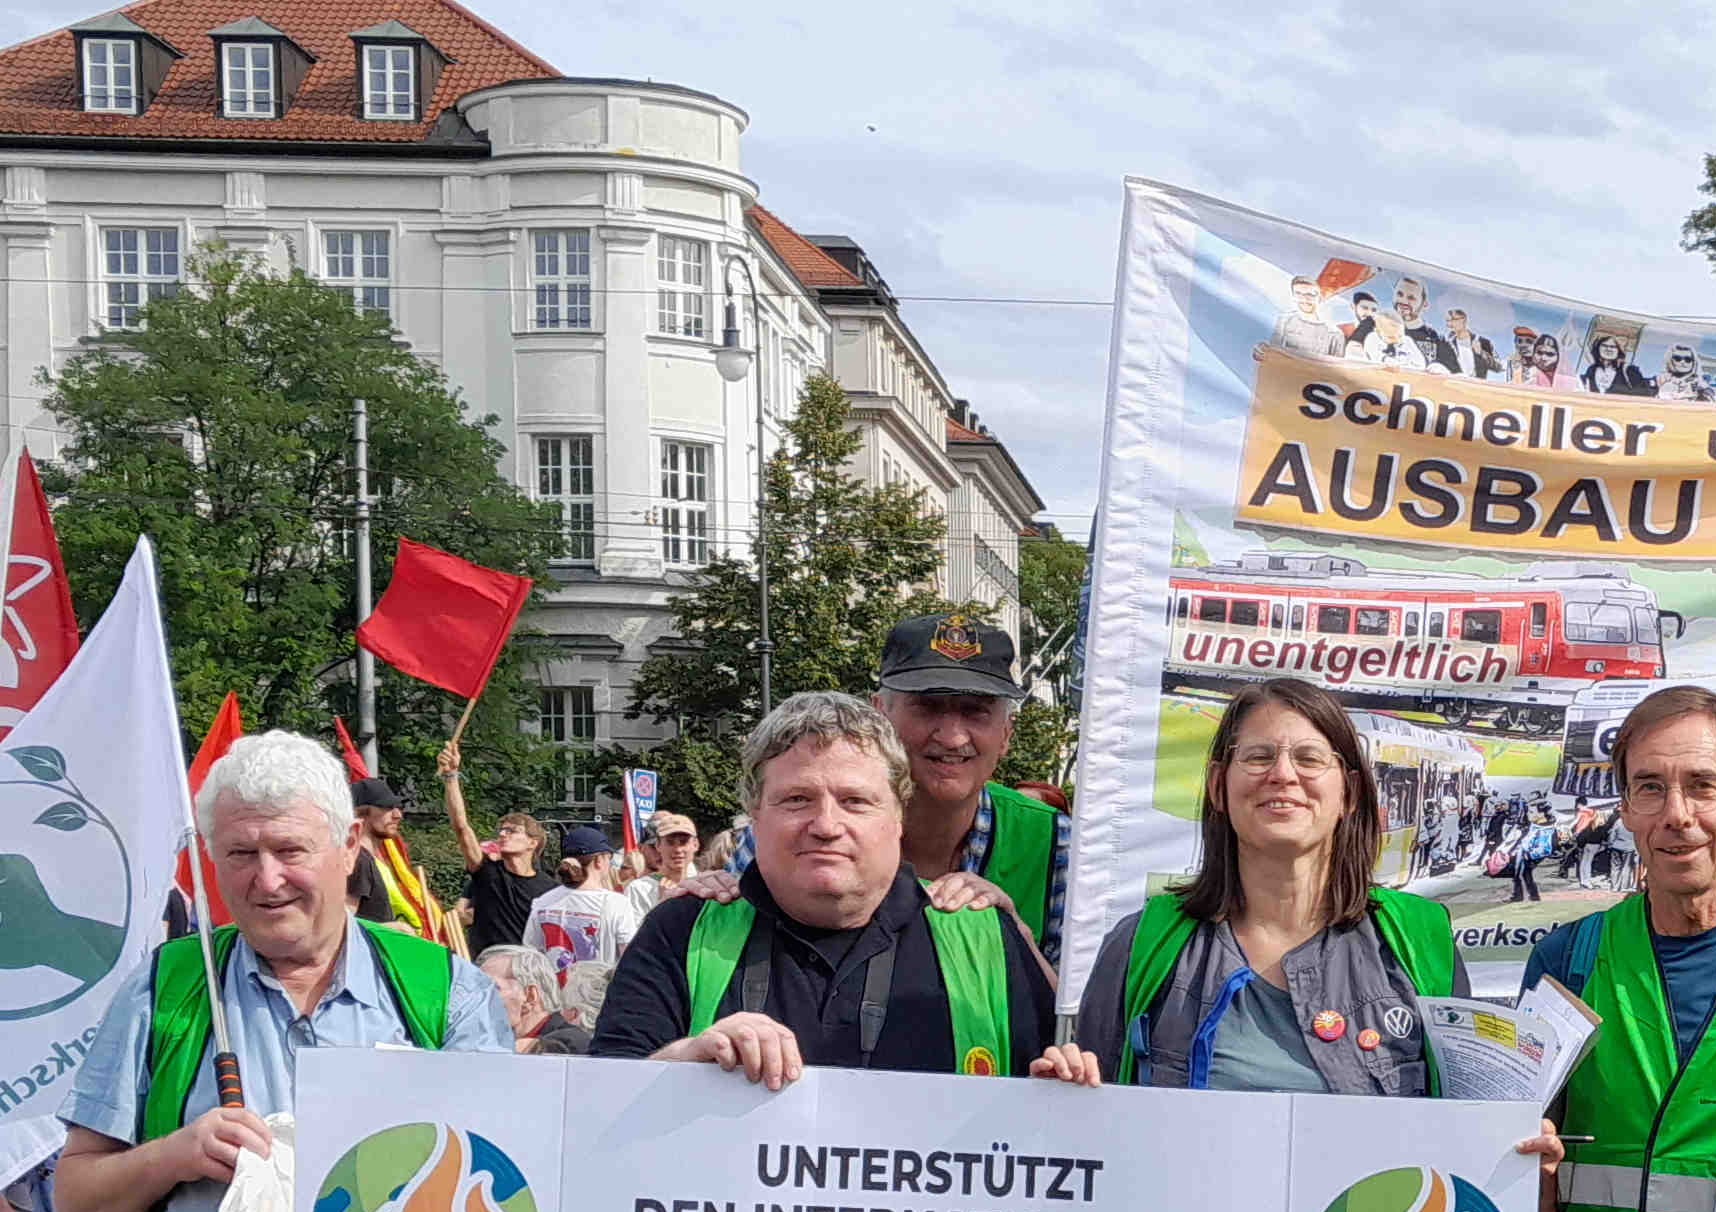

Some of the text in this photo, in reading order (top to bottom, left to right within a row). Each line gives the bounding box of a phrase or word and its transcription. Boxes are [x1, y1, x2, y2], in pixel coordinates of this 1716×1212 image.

[1300, 384, 1652, 456] schneller
[1250, 442, 1698, 545] AUSBAU
[1183, 631, 1507, 685] unentgeltlich
[757, 1141, 1104, 1202] UNTERSTÜTZT
